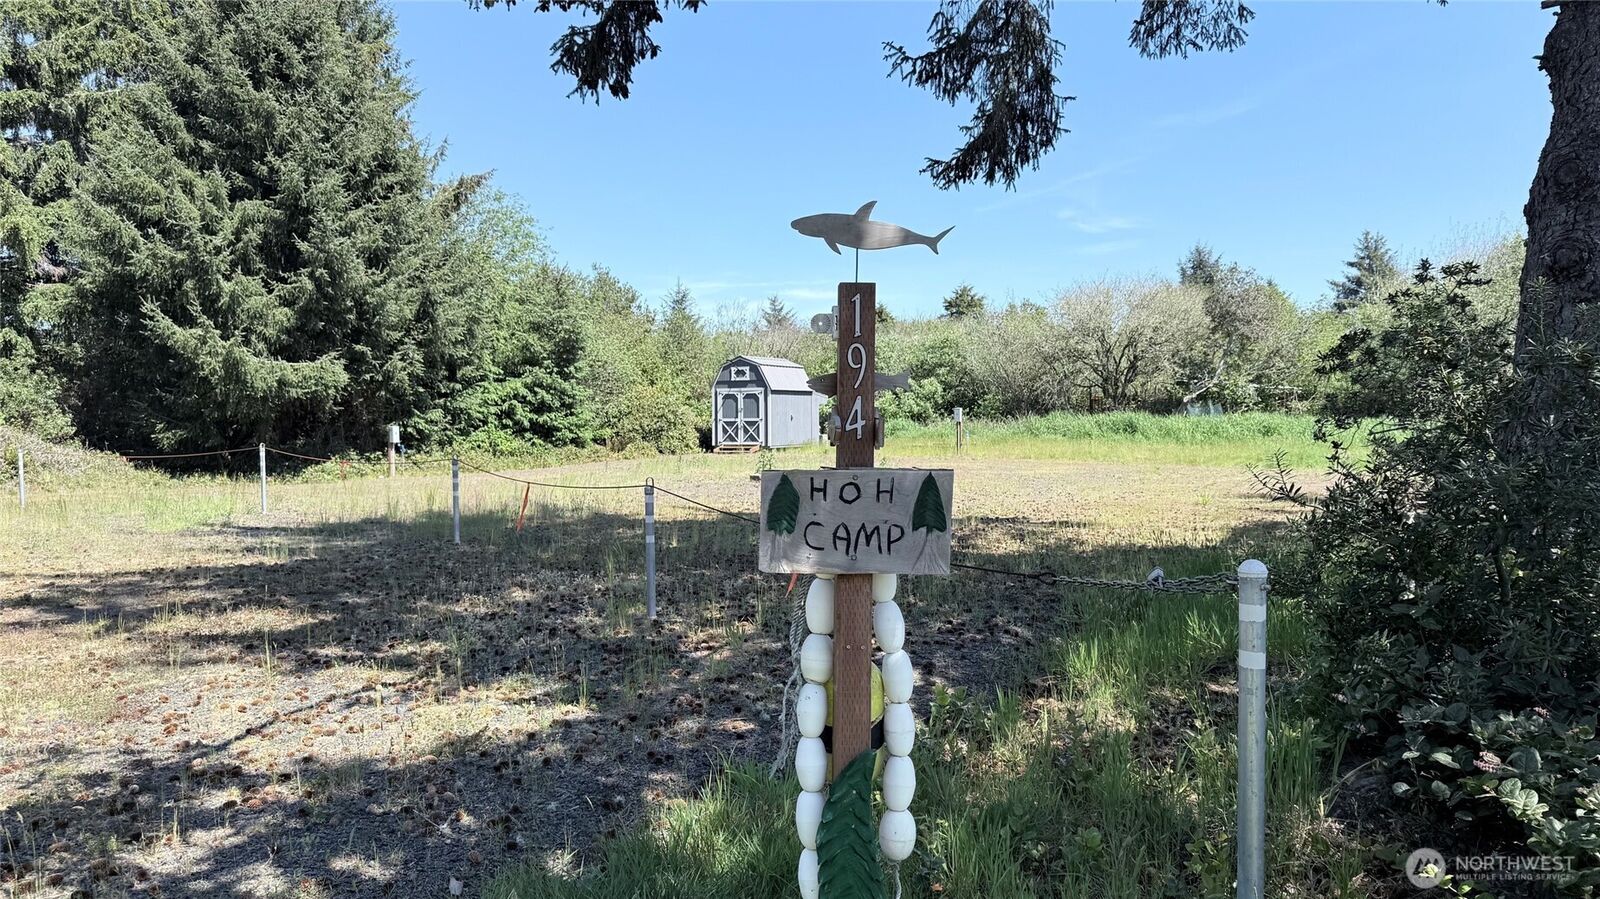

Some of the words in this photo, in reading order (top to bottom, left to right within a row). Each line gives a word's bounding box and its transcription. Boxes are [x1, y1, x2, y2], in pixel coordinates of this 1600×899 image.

[845, 293, 867, 440] 194
[809, 477, 895, 505] HOH
[803, 521, 906, 556] CAMP
